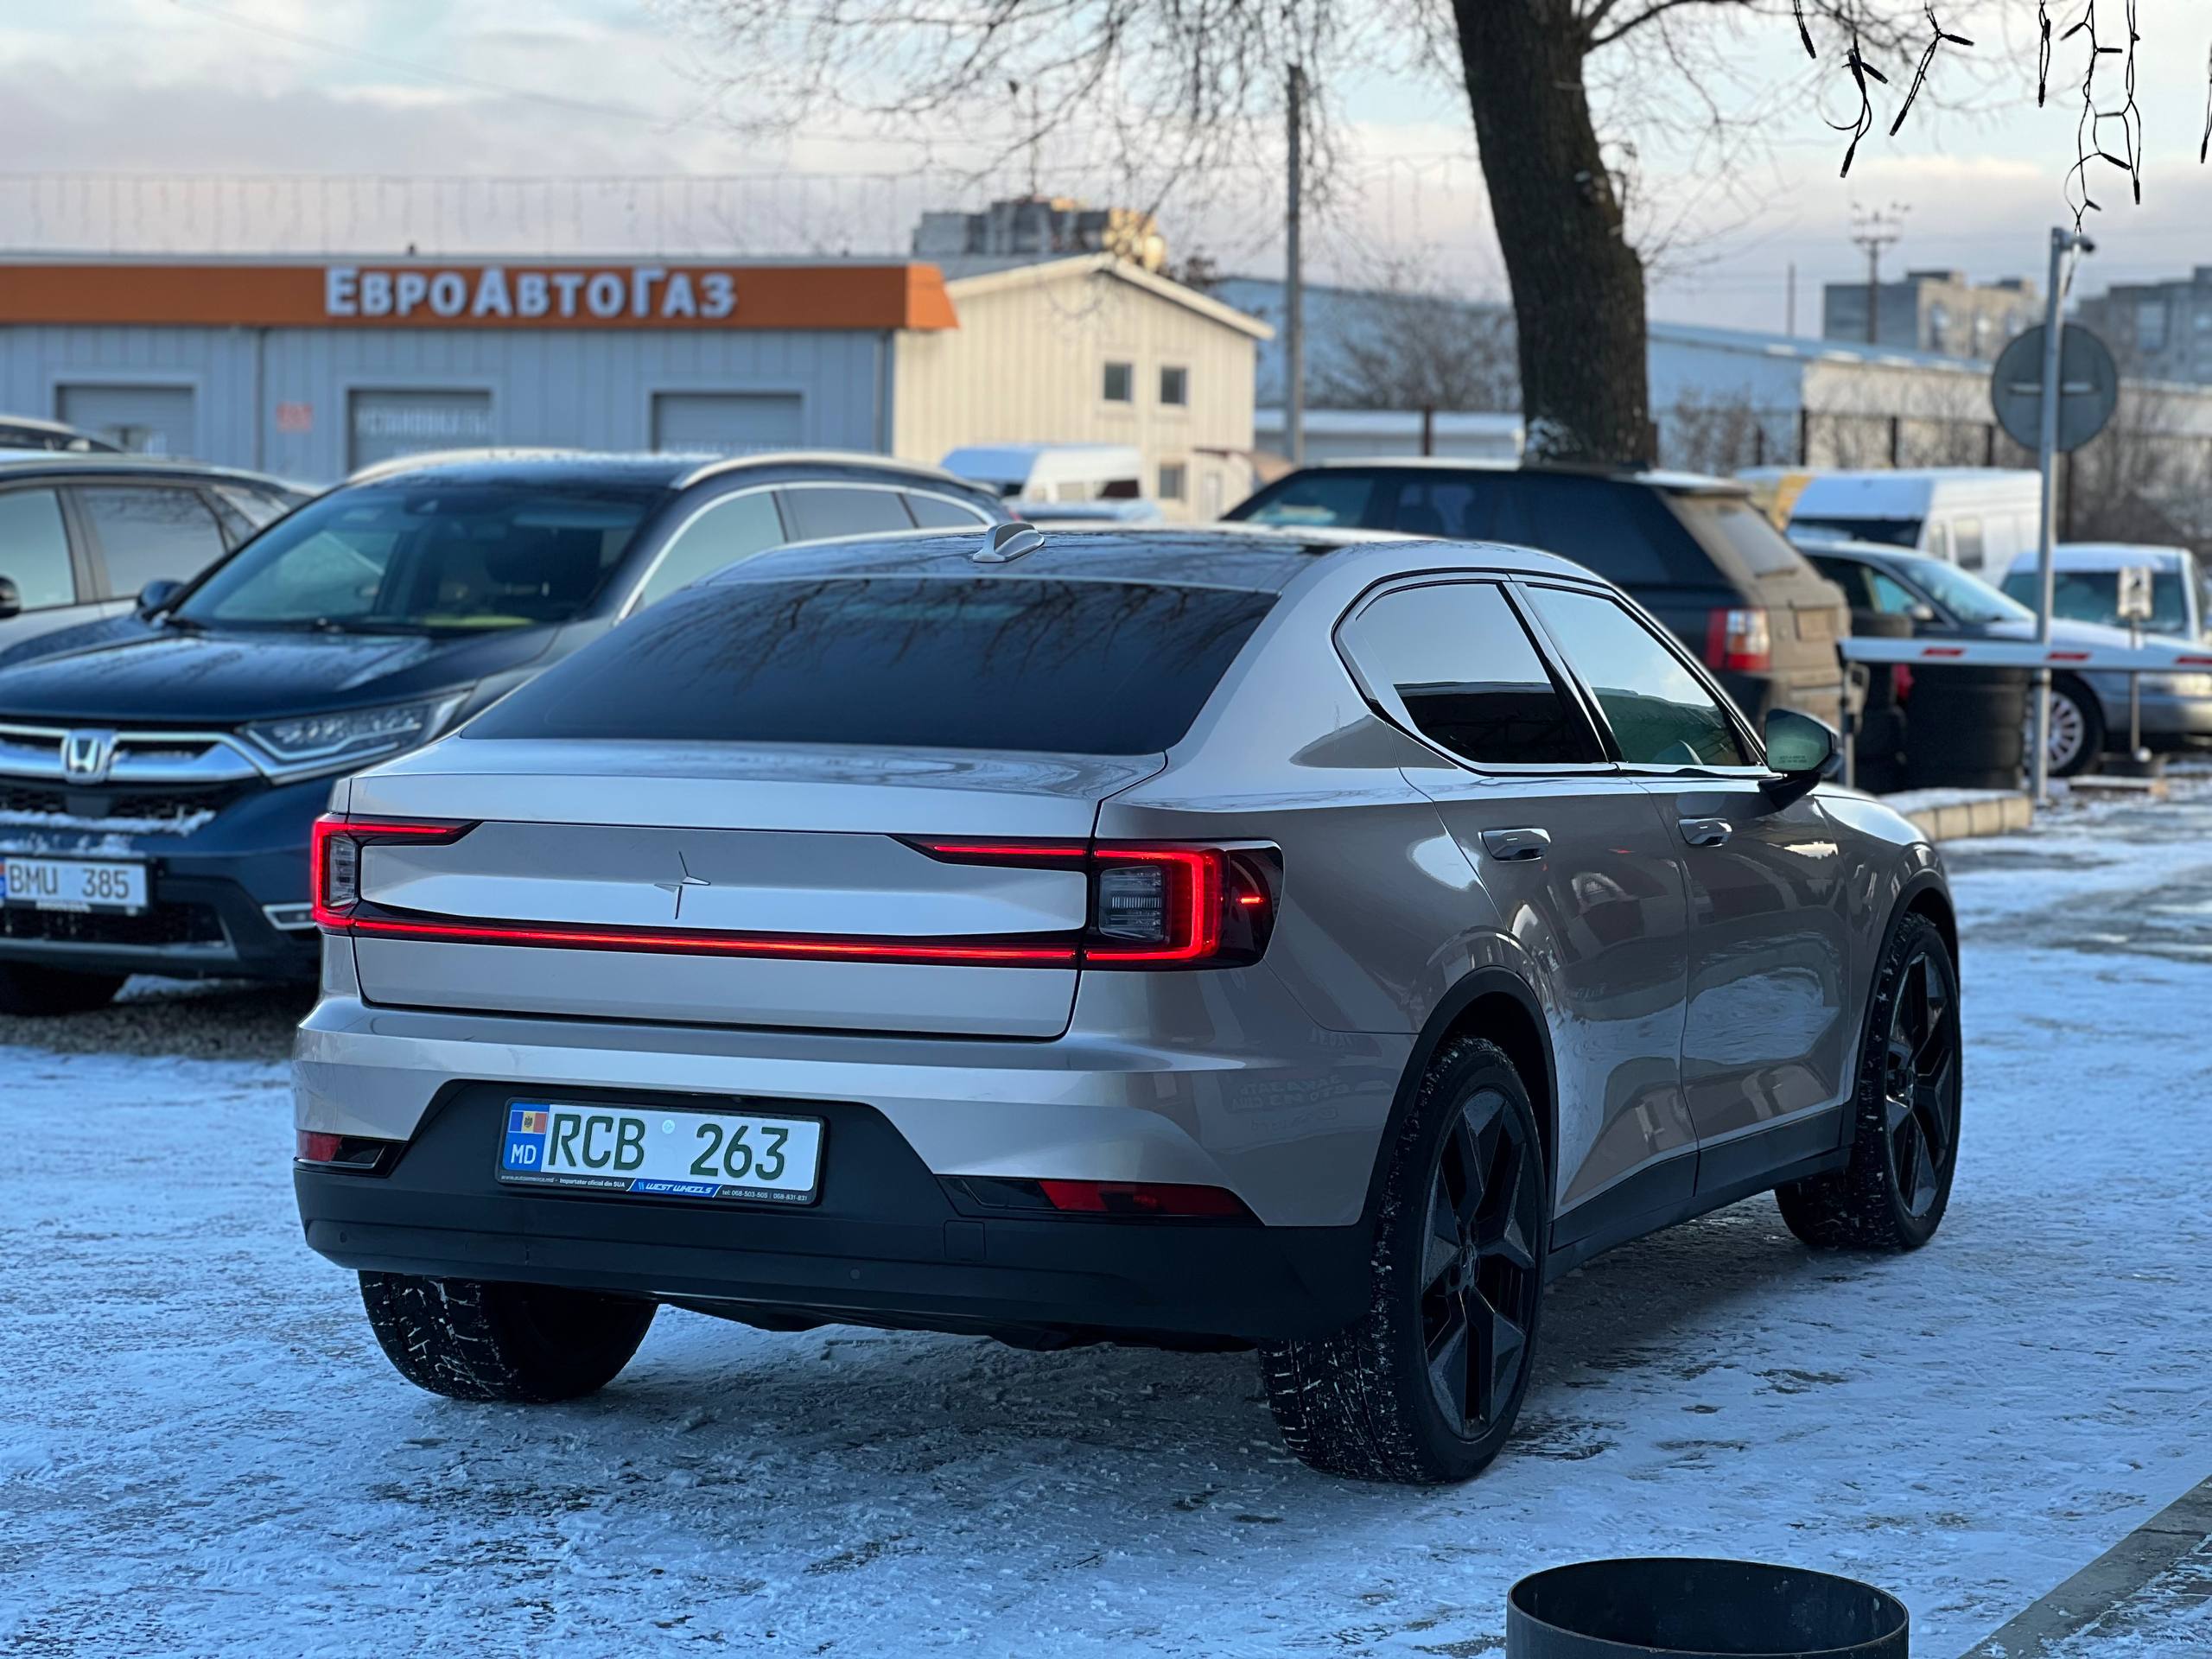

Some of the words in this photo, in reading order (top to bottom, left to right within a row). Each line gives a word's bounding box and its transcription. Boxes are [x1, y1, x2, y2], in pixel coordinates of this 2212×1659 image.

[10, 864, 58, 895] BMU
[82, 868, 130, 899] 385
[510, 1143, 536, 1165] MD
[548, 1113, 646, 1171] RCB
[690, 1123, 790, 1180] 263
[645, 1183, 674, 1192] WEST
[673, 1184, 713, 1194] WHEELS
